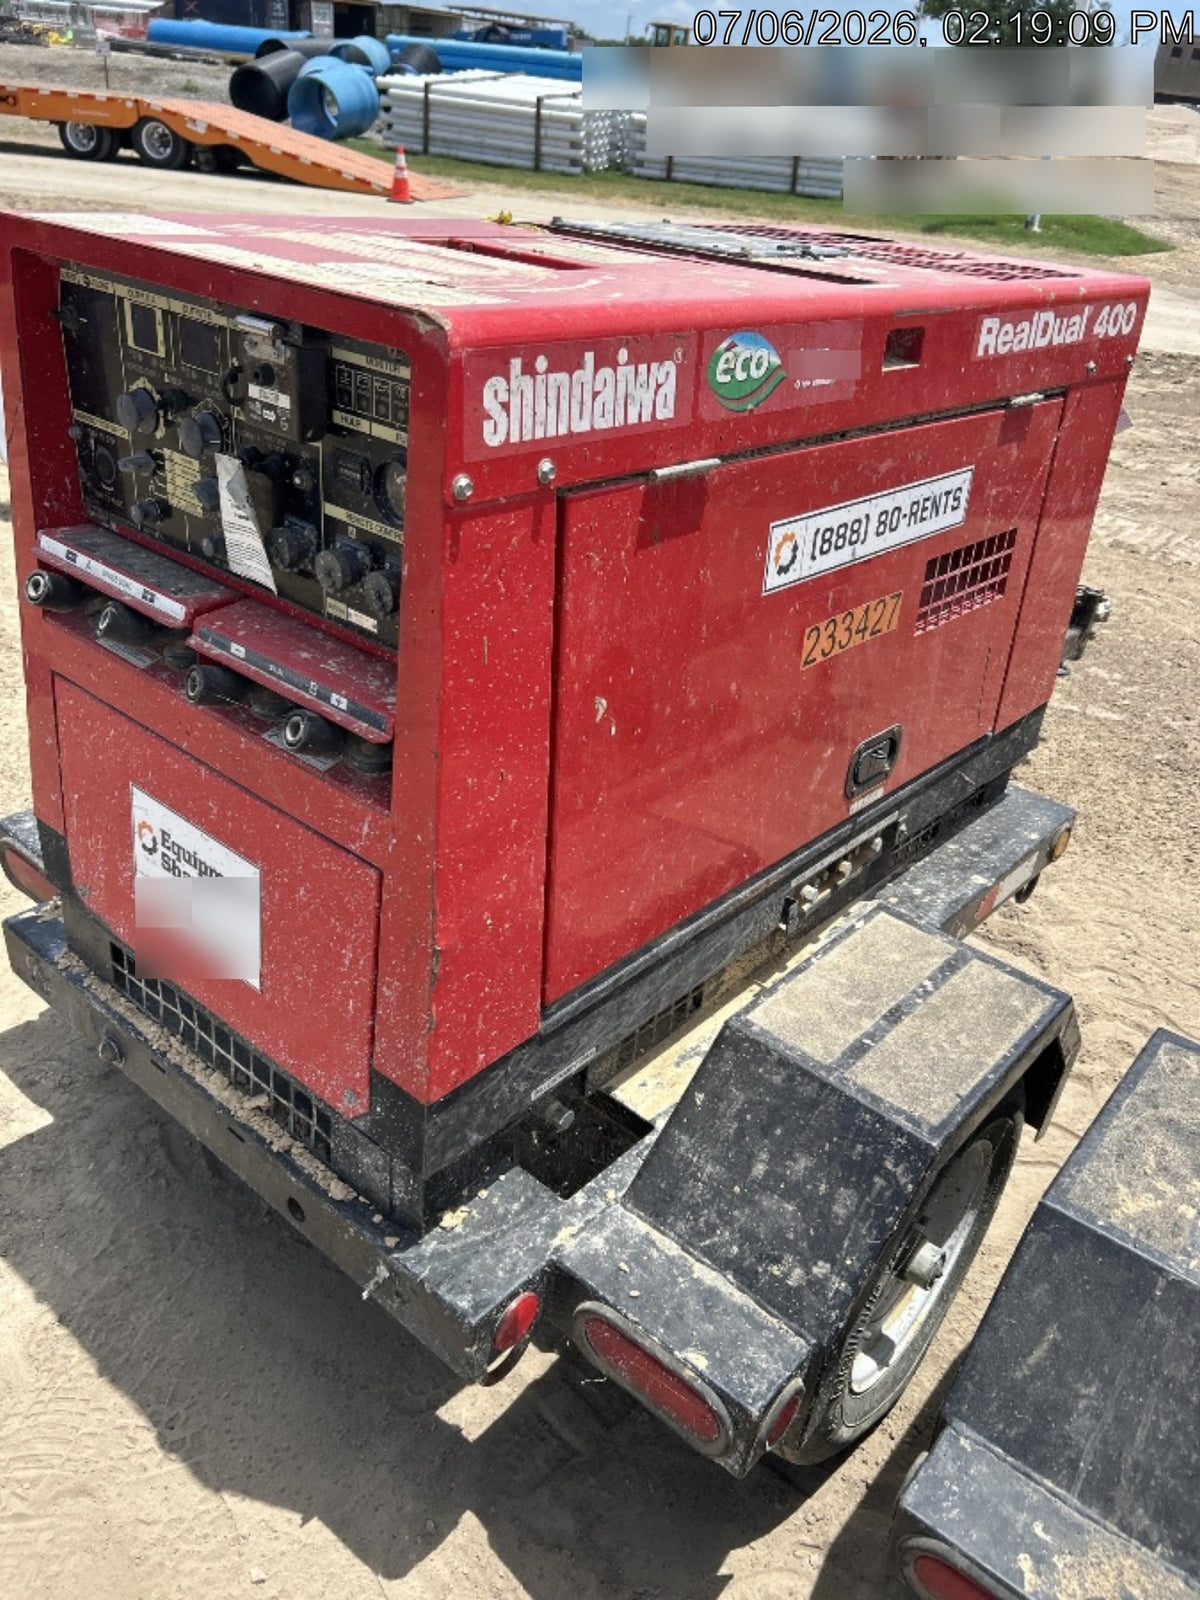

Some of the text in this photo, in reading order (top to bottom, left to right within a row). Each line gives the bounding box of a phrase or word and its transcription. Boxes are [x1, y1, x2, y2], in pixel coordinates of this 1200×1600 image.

[977, 302, 1137, 356] RealDual 400
[483, 347, 677, 447] shindaiwa
[810, 487, 963, 561] (888) 80-RENTS
[803, 592, 902, 668] 233427
[160, 829, 225, 878] Equipm
